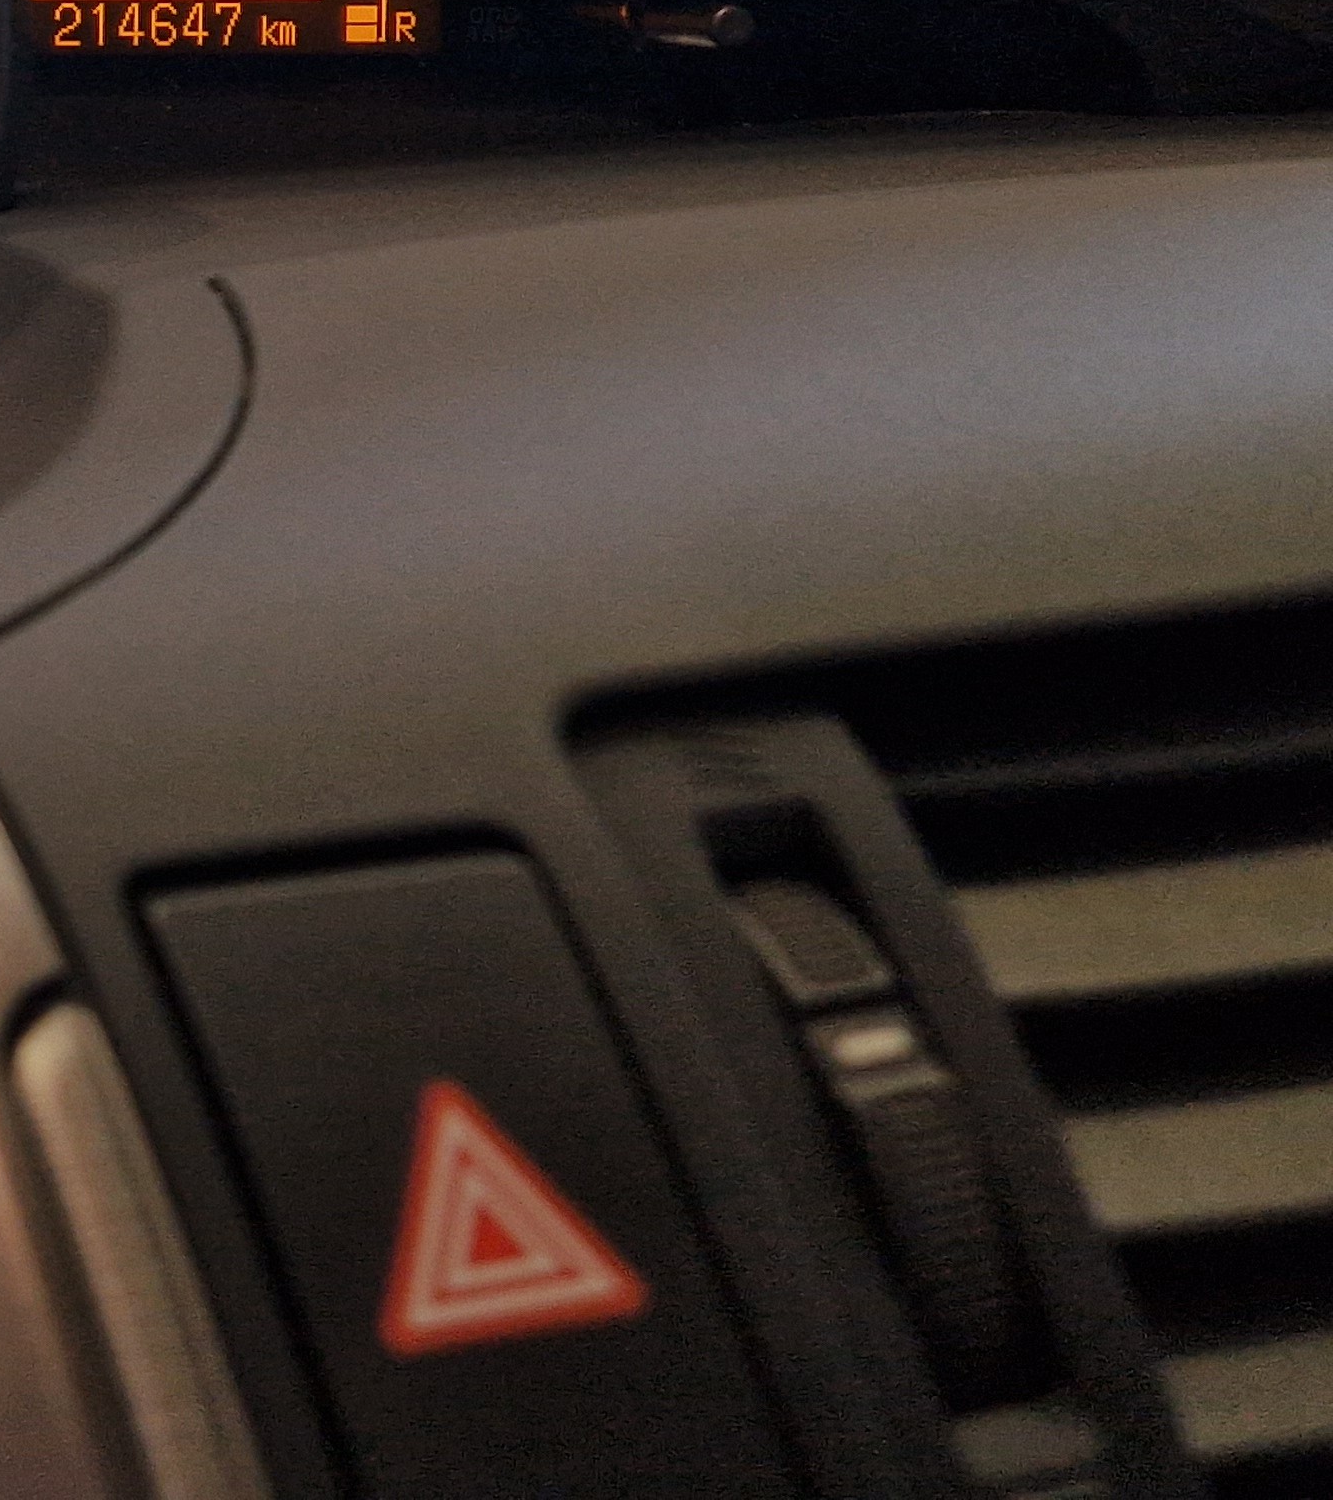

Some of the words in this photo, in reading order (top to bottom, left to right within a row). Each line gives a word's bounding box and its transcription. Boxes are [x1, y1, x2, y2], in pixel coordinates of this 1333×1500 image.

[53, 1, 242, 47] 214647
[260, 14, 297, 47] km
[395, 11, 417, 43] R
